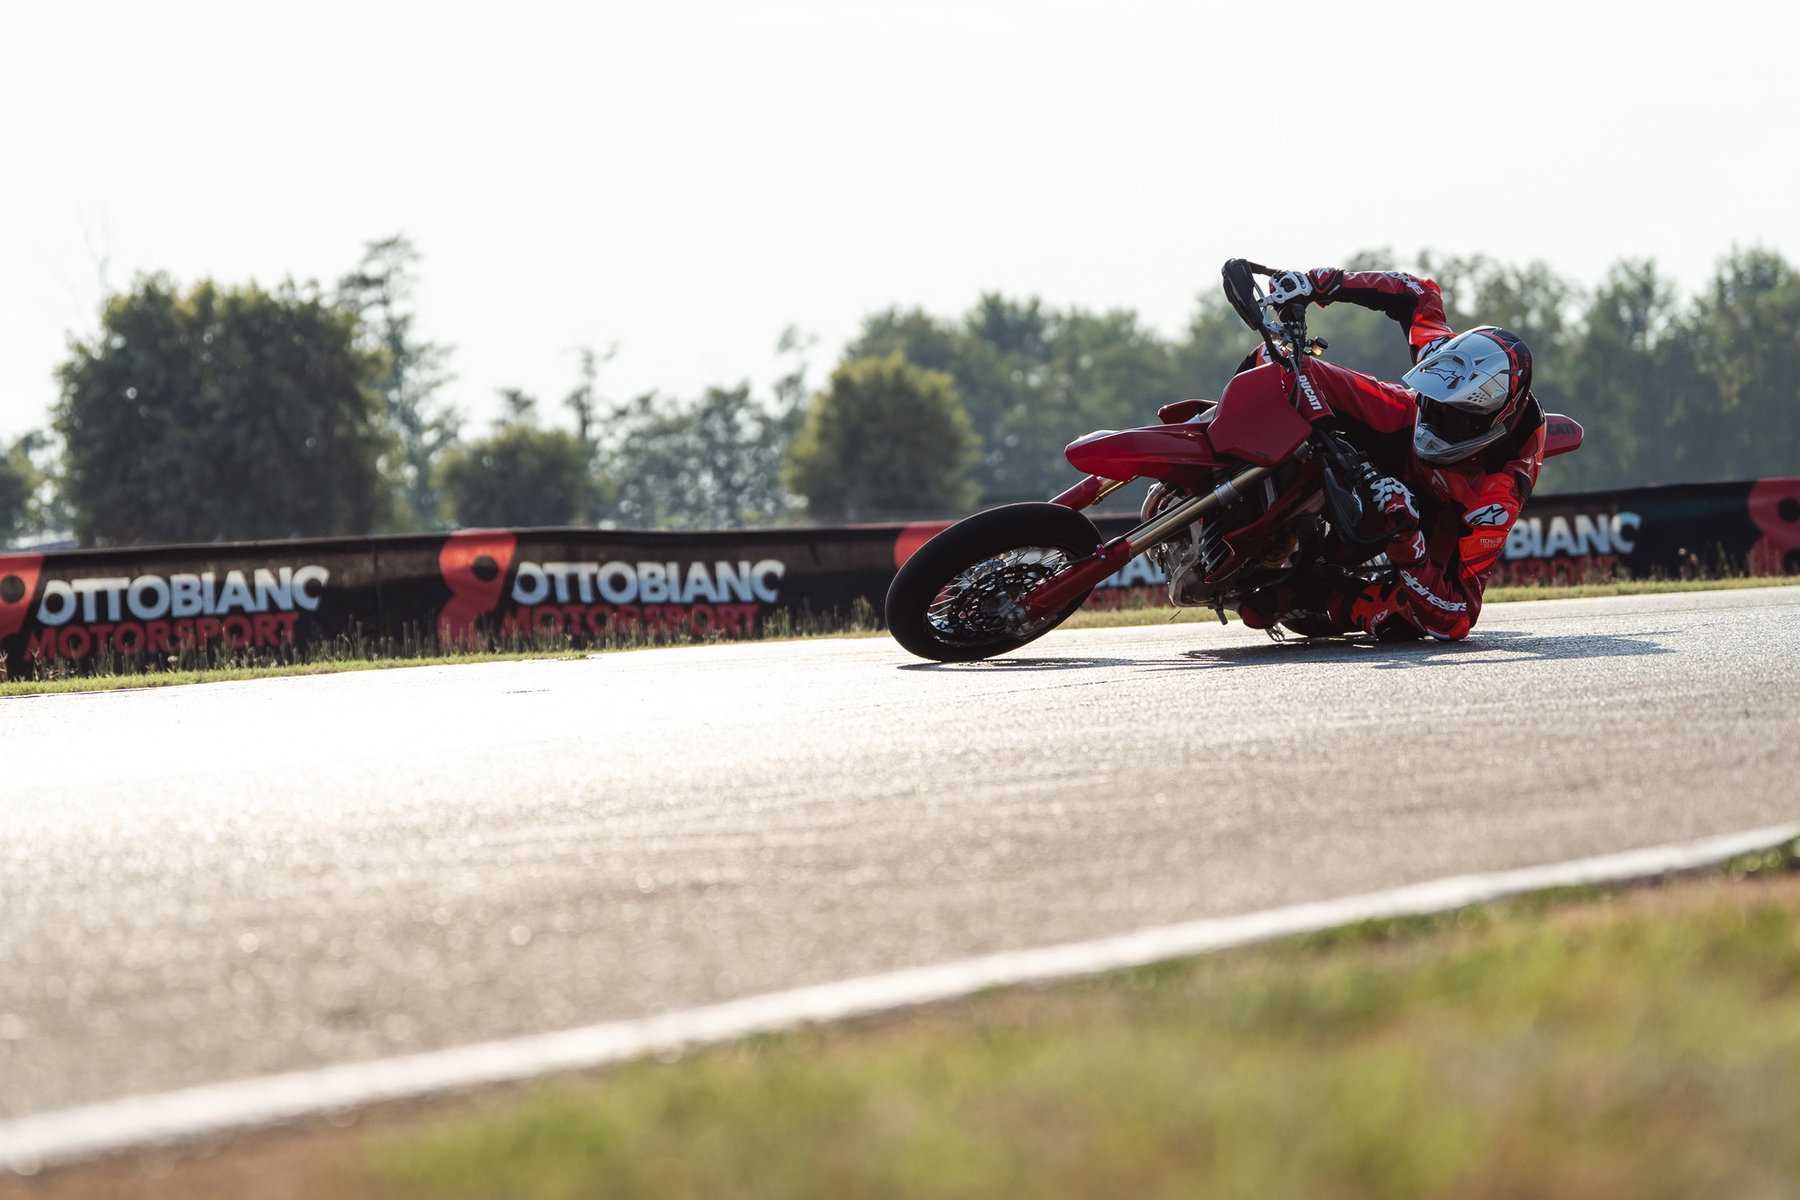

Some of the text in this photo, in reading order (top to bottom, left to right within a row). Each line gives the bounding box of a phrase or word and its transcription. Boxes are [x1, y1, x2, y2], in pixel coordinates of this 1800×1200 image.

[1298, 374, 1323, 411] DUCATI
[1547, 423, 1577, 435] CATI
[23, 612, 300, 662] MOTORSPORT
